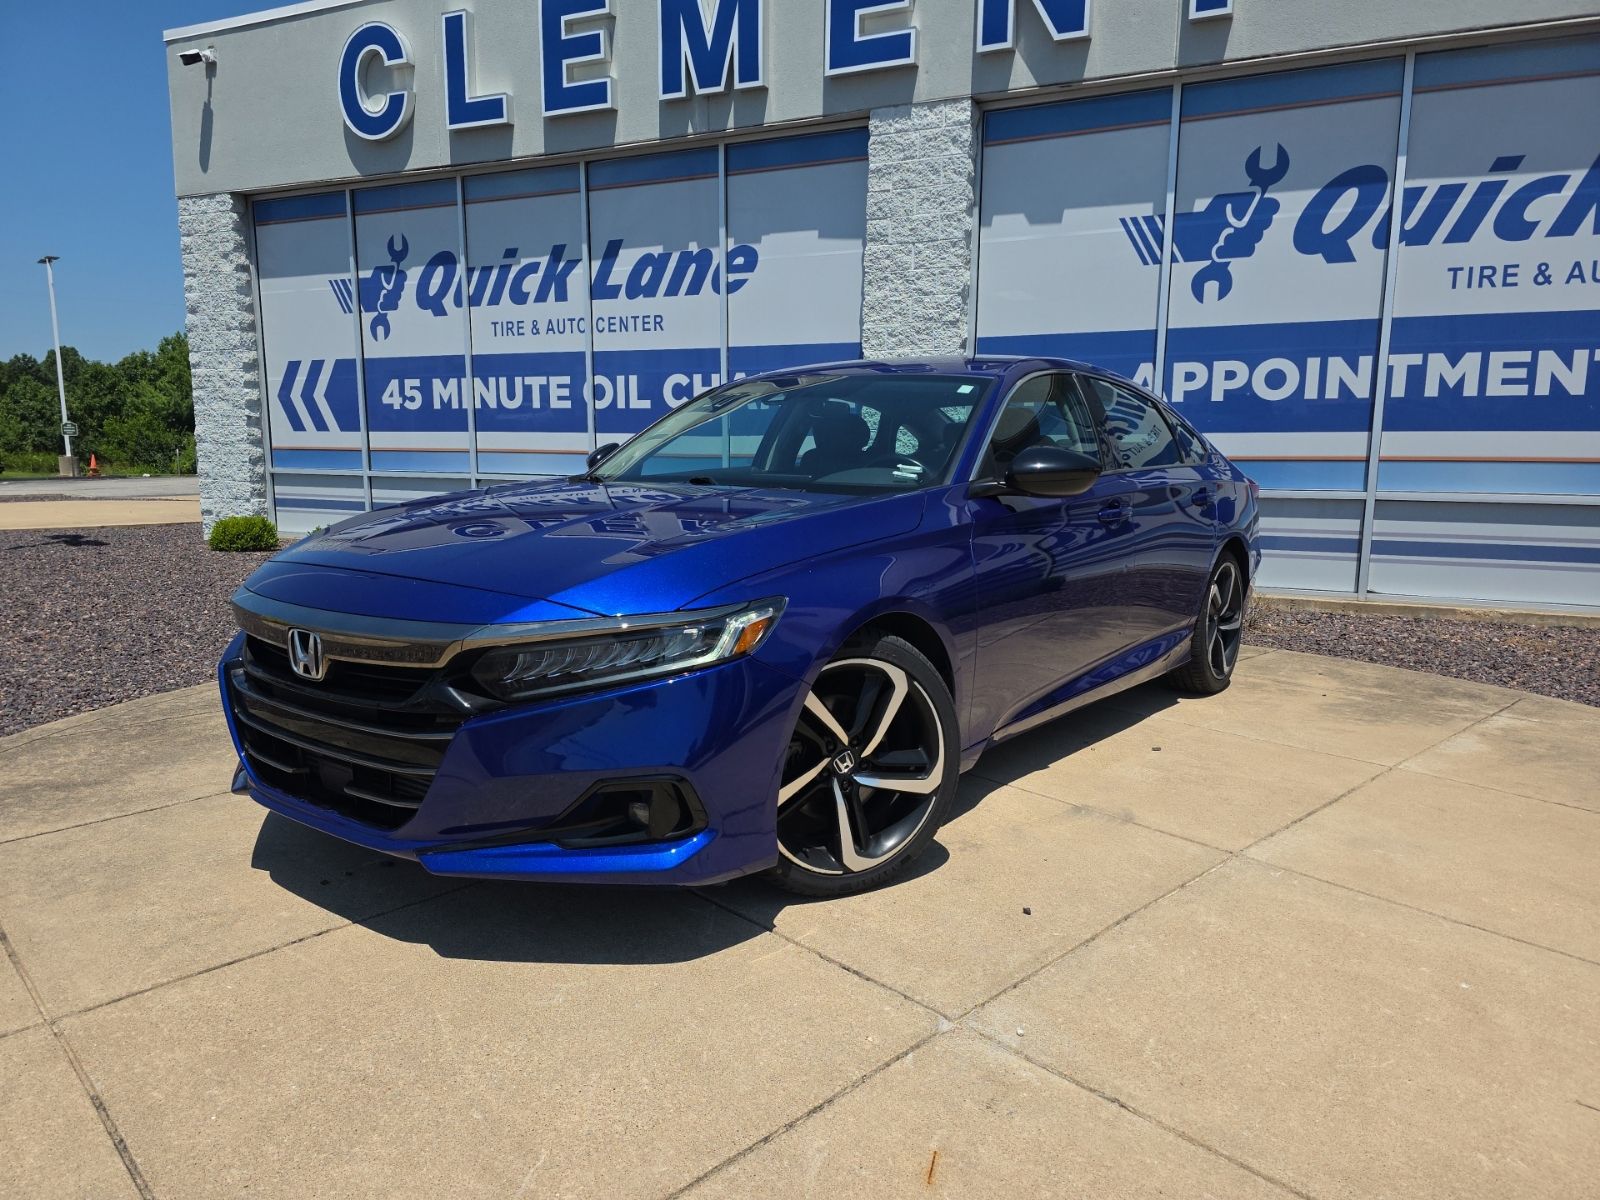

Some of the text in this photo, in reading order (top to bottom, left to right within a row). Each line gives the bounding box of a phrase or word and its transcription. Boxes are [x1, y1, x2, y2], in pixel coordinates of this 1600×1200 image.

[338, 0, 1233, 141] CLEME
[416, 238, 759, 317] Quick Lane
[1447, 263, 1520, 290] TIRE
[1533, 262, 1553, 286] &
[491, 317, 525, 337] TIRE
[531, 319, 541, 336] &
[596, 314, 665, 333] CENTER
[381, 377, 423, 411] 45
[432, 375, 571, 410] MINUTE
[583, 373, 651, 410] OIL
